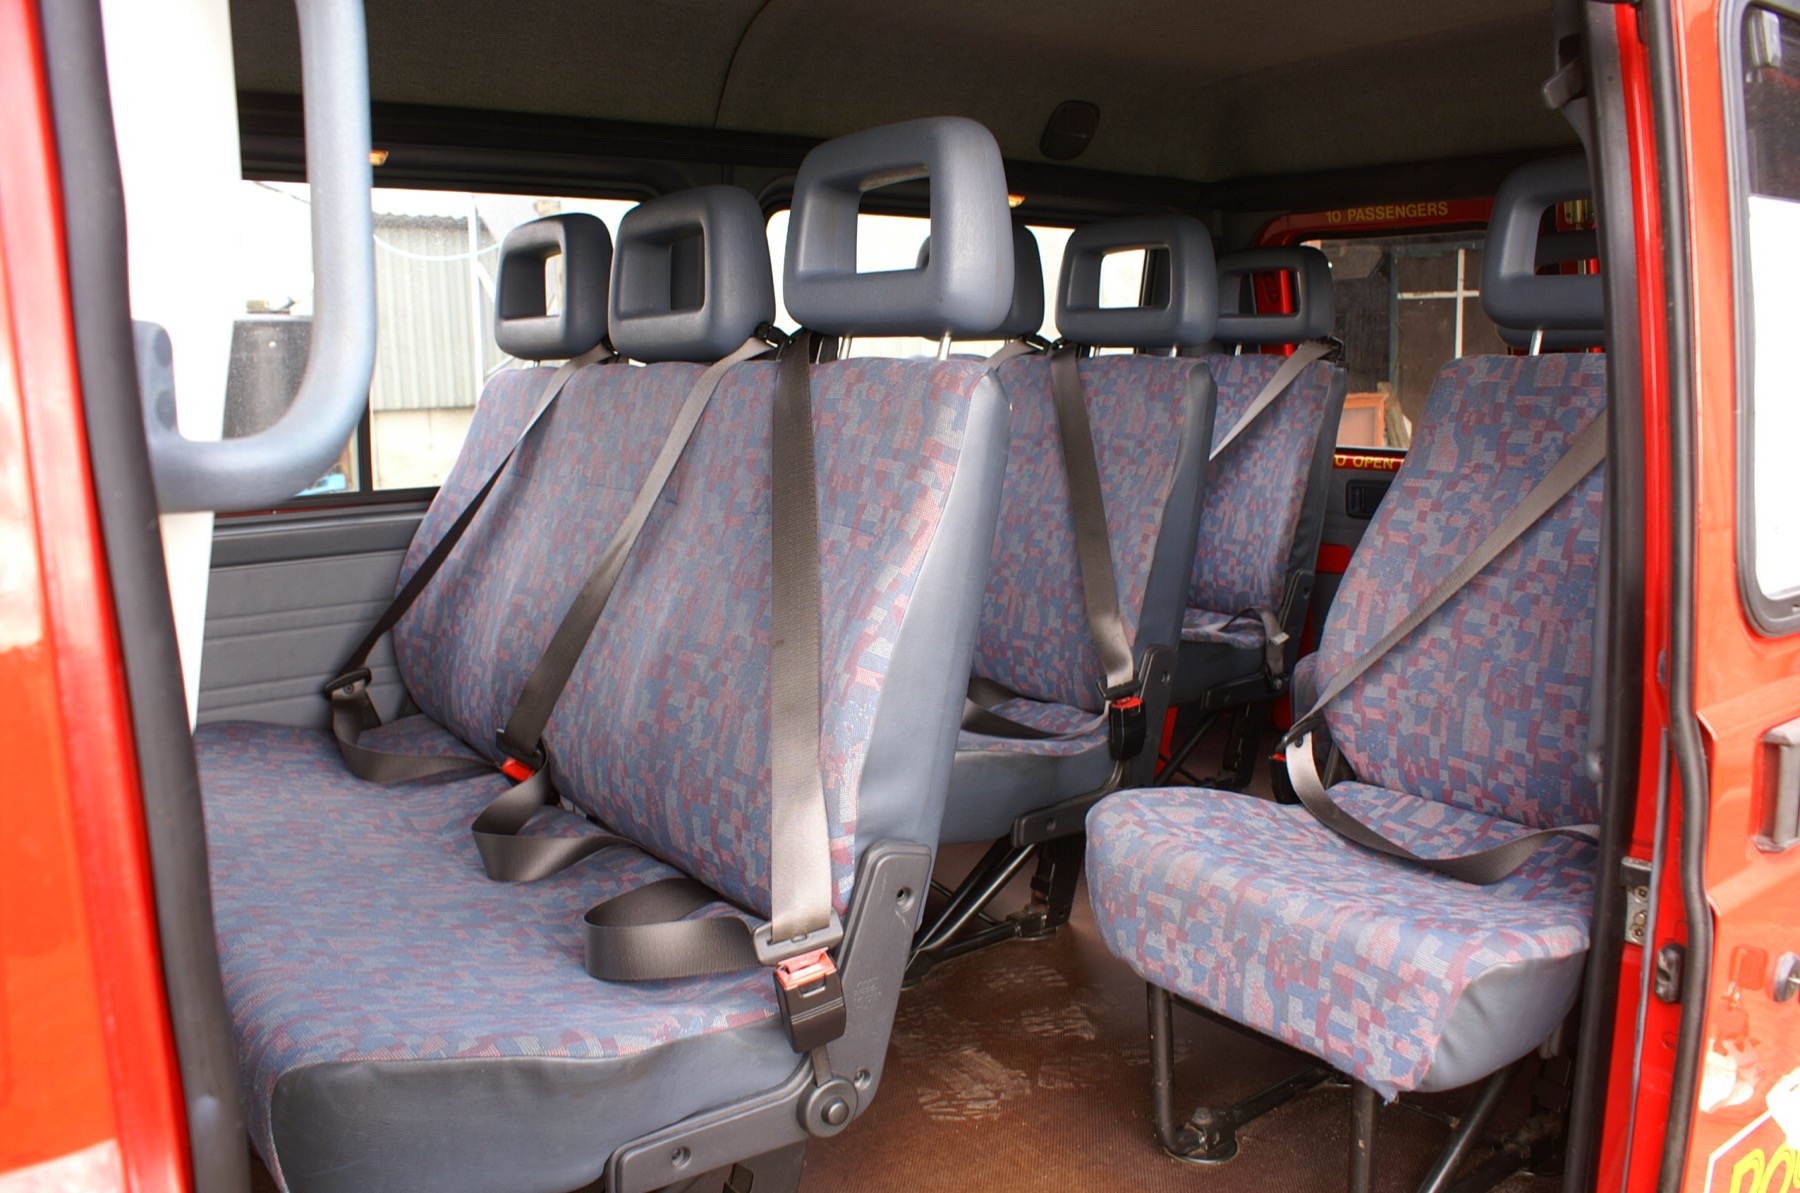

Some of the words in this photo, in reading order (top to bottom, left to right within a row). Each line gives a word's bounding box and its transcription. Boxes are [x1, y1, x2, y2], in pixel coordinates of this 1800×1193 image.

[1326, 210, 1342, 223] 10
[1347, 201, 1449, 222] PASSENGERS
[1334, 454, 1347, 467] O
[1352, 455, 1395, 469] OPEN
